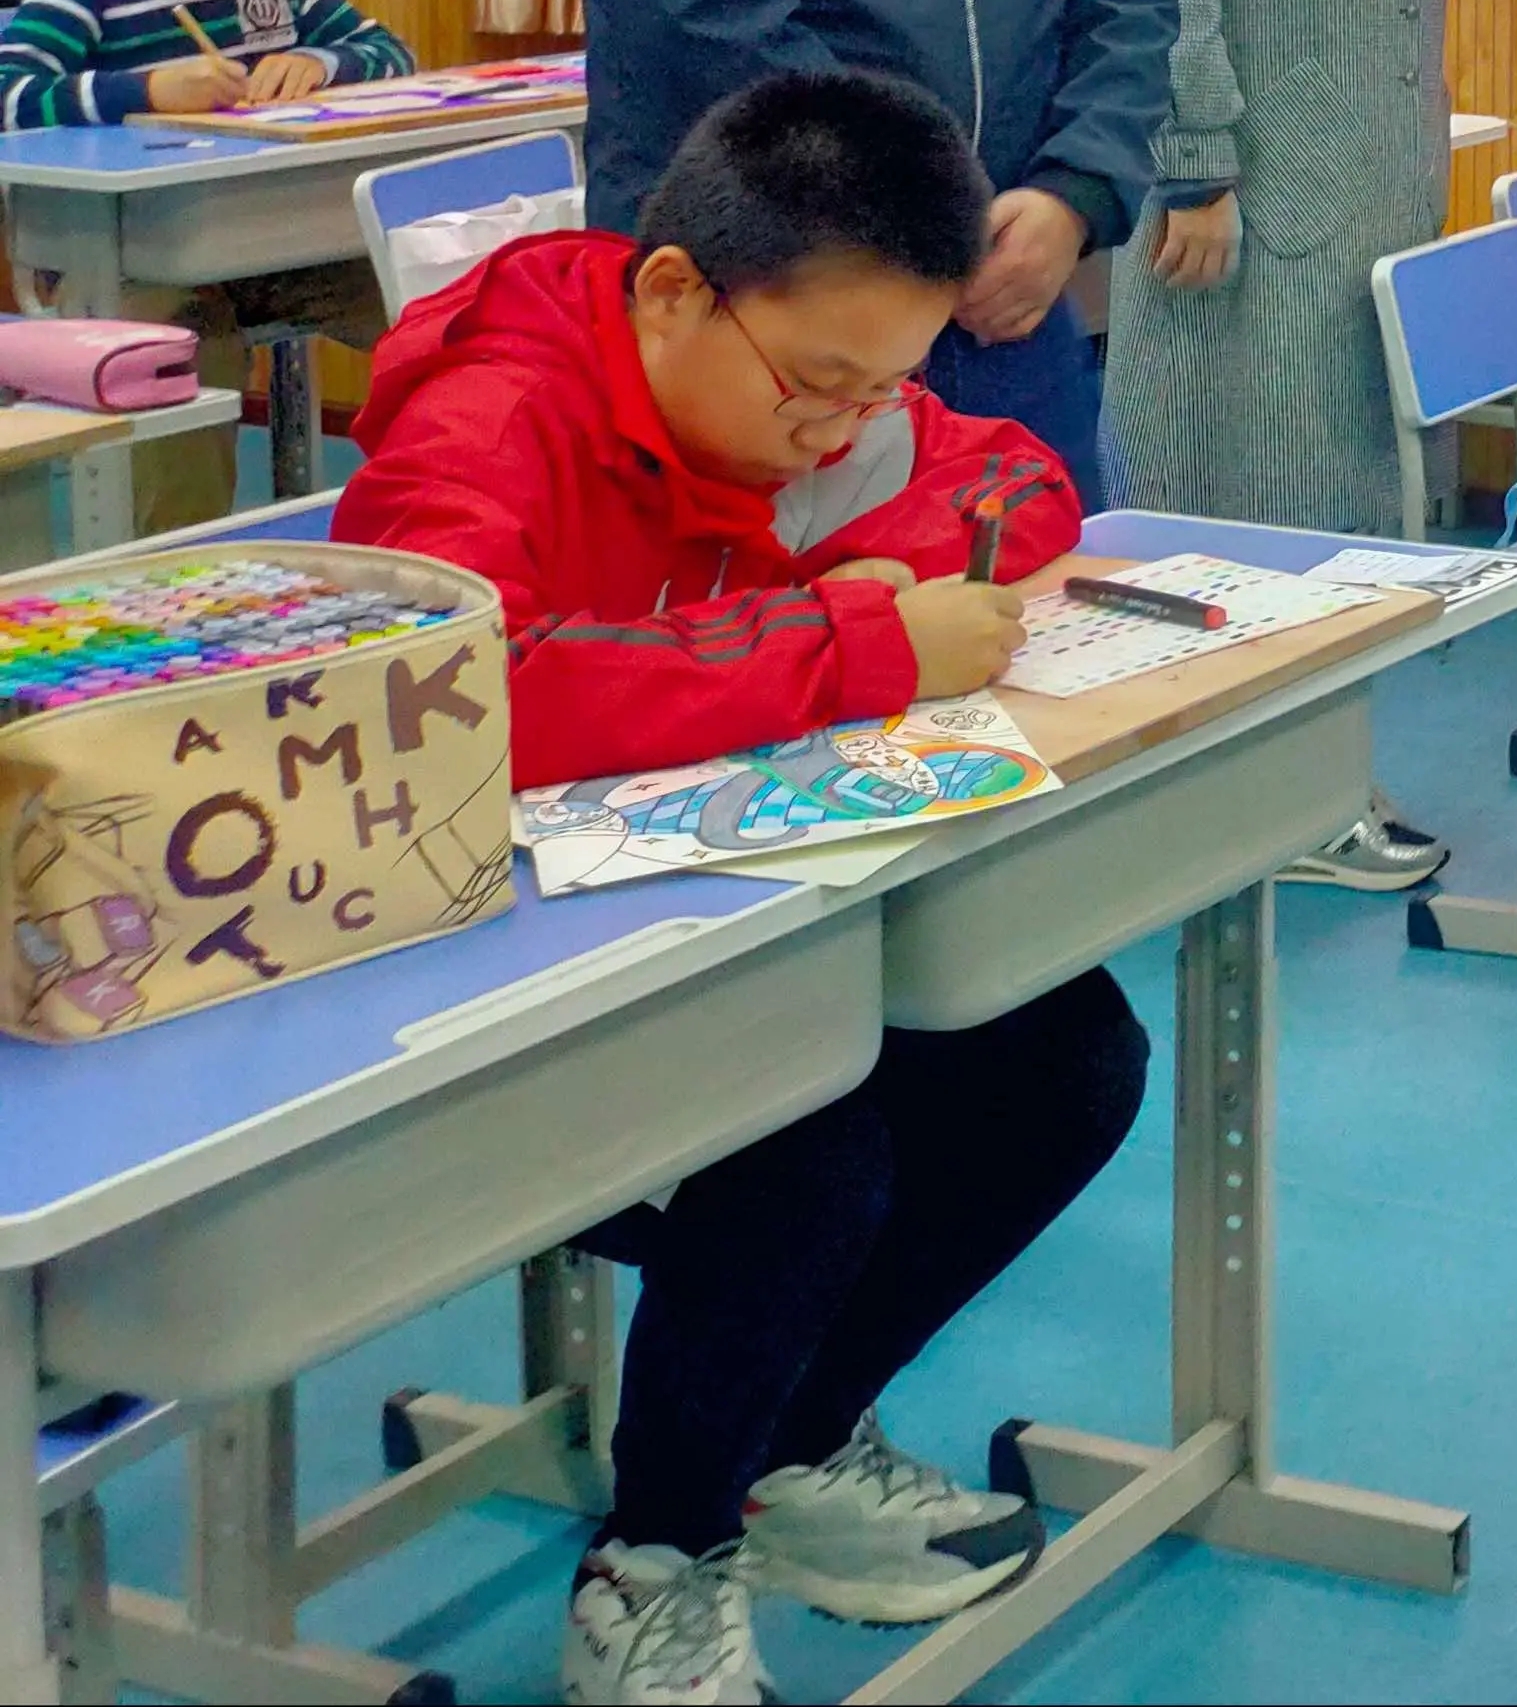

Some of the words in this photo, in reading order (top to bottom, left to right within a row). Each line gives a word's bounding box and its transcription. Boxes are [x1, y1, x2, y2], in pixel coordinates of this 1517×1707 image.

[386, 643, 489, 753] K
[173, 717, 223, 764] A
[278, 722, 363, 801] M
[164, 789, 278, 899] O
[353, 779, 419, 849] H
[288, 858, 327, 905] U
[331, 887, 376, 932] C
[184, 903, 287, 979] T
